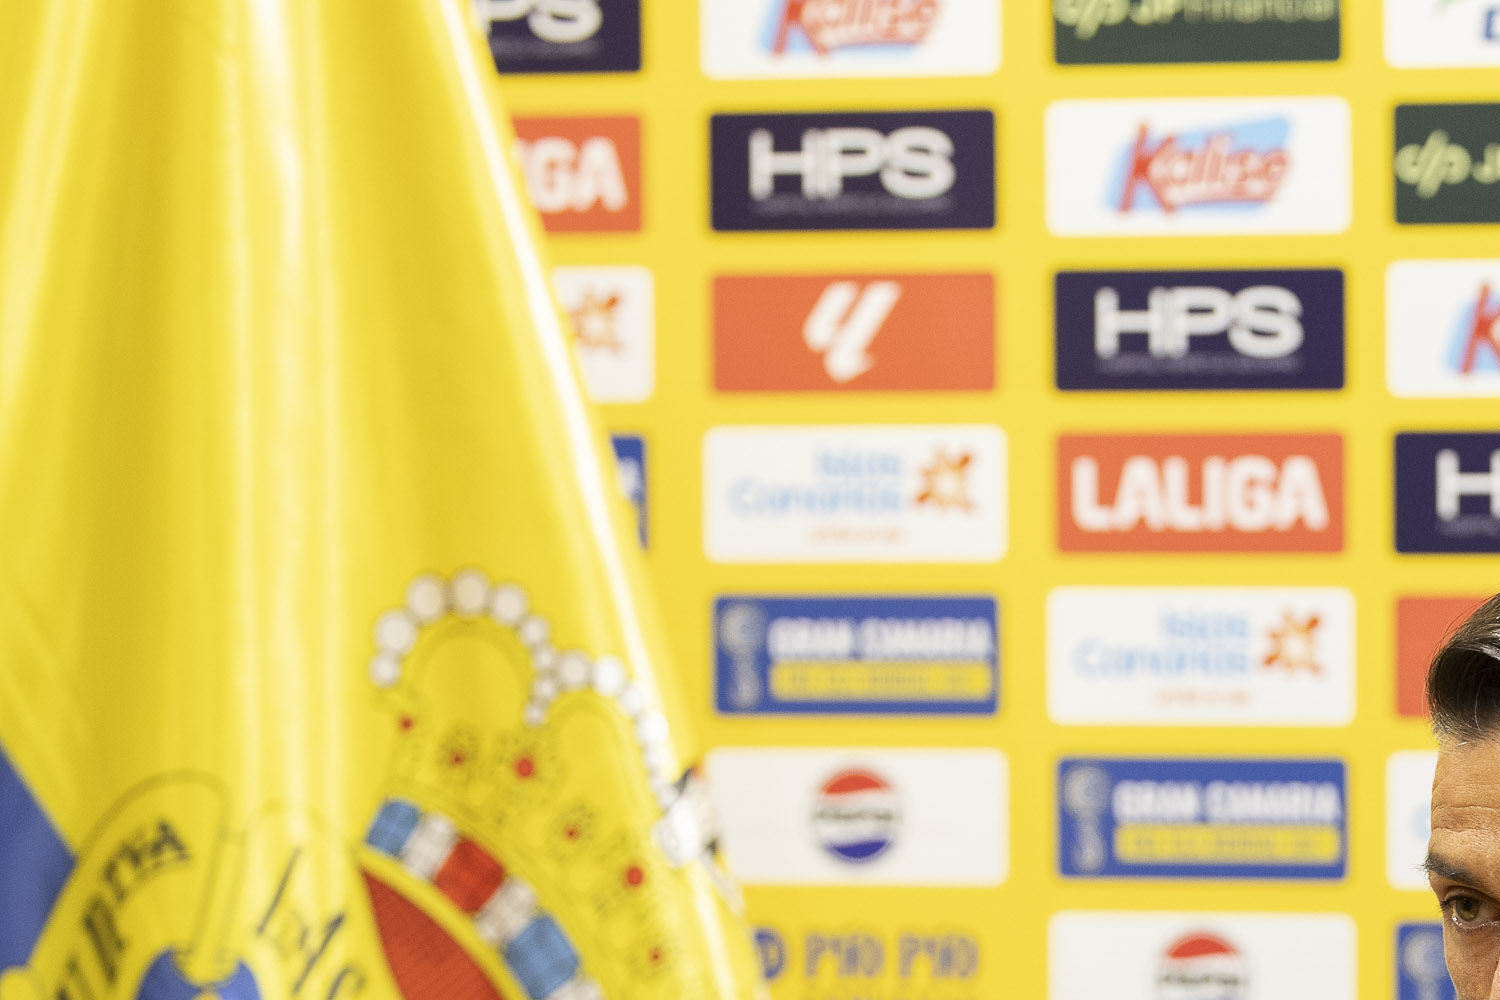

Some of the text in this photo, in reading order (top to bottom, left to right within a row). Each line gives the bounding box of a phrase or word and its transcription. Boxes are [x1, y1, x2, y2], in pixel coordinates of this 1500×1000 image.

[750, 127, 954, 198] HPS
[1095, 286, 1302, 359] HPS
[1070, 454, 1329, 532] LALIGA
